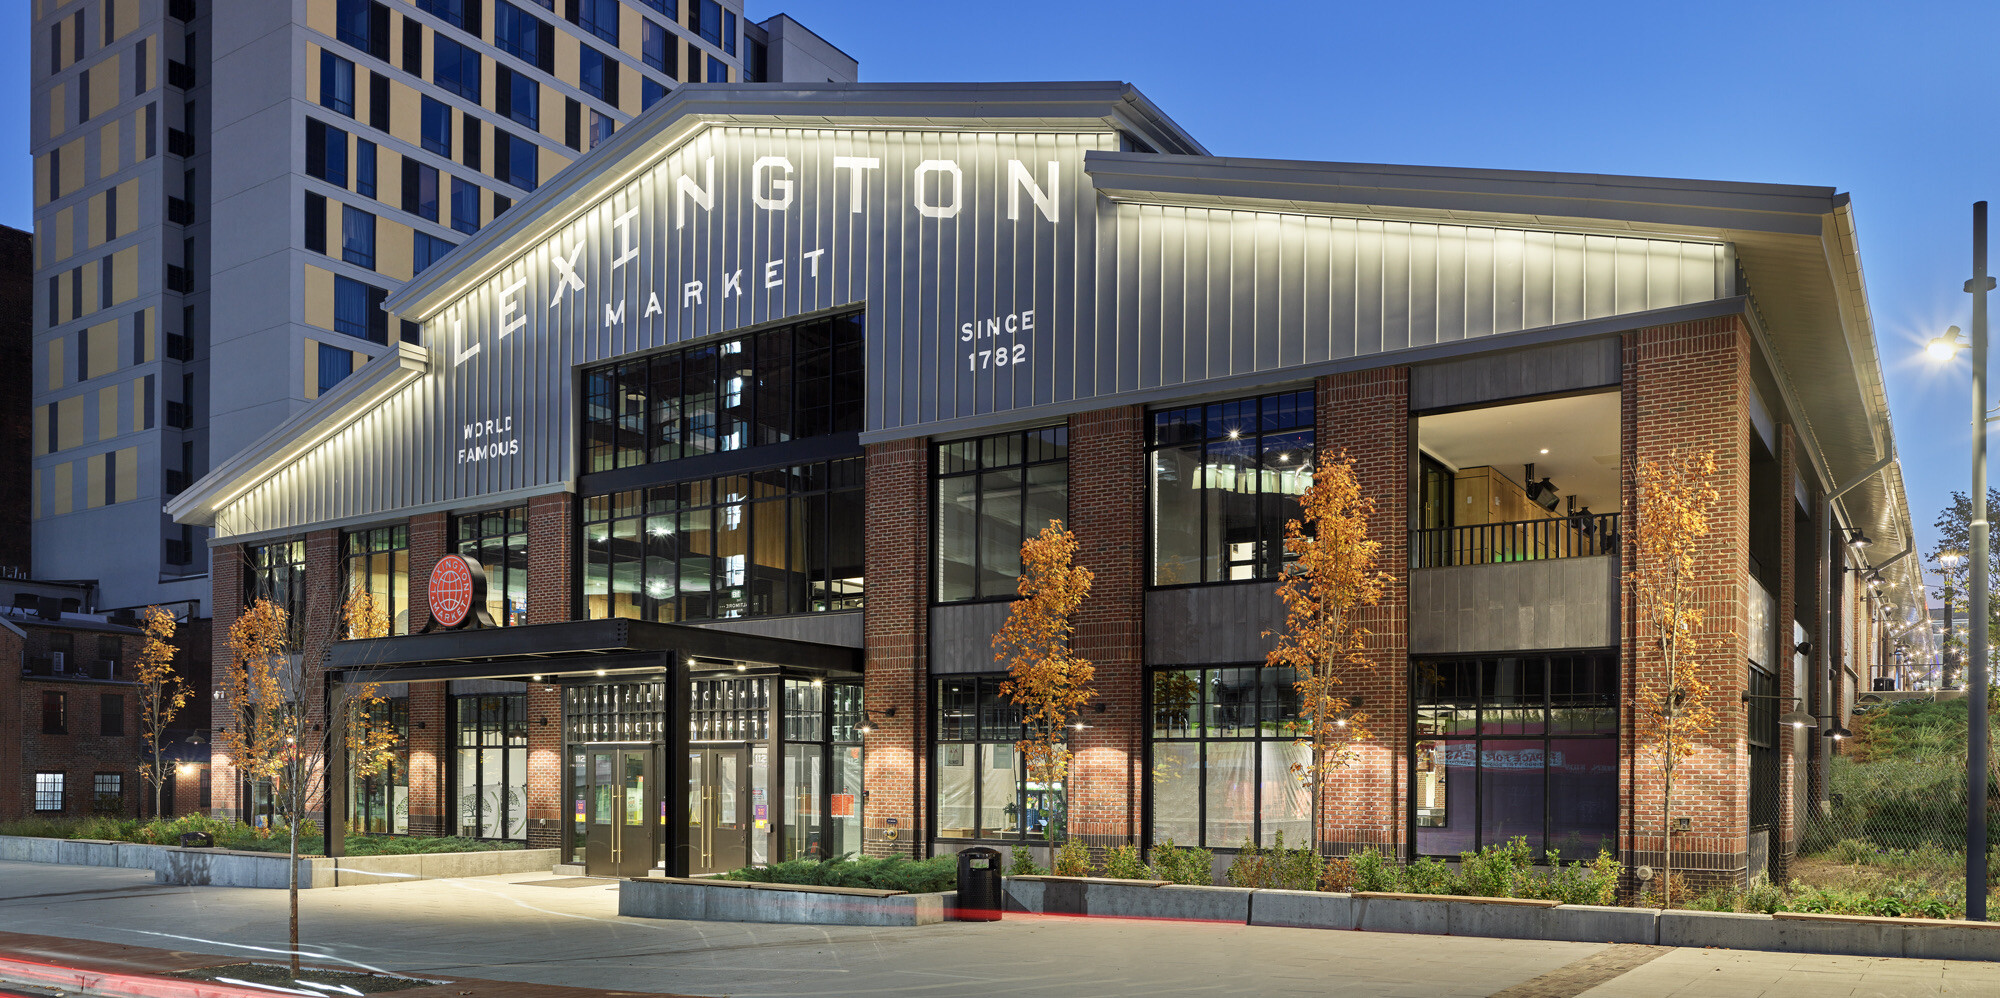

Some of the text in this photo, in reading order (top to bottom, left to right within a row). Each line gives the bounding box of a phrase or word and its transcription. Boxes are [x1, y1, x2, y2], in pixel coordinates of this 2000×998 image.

[454, 155, 1059, 367] LEXINGTON
[605, 248, 825, 328] MARKET
[961, 309, 1034, 342] SINCE
[968, 343, 1026, 372] 1782
[463, 415, 512, 440] WORLD
[458, 438, 519, 464] FAMOUS
[430, 560, 470, 593] LEXINGTON
[432, 600, 467, 622] MARKET
[582, 721, 664, 734] LEXINGTO
